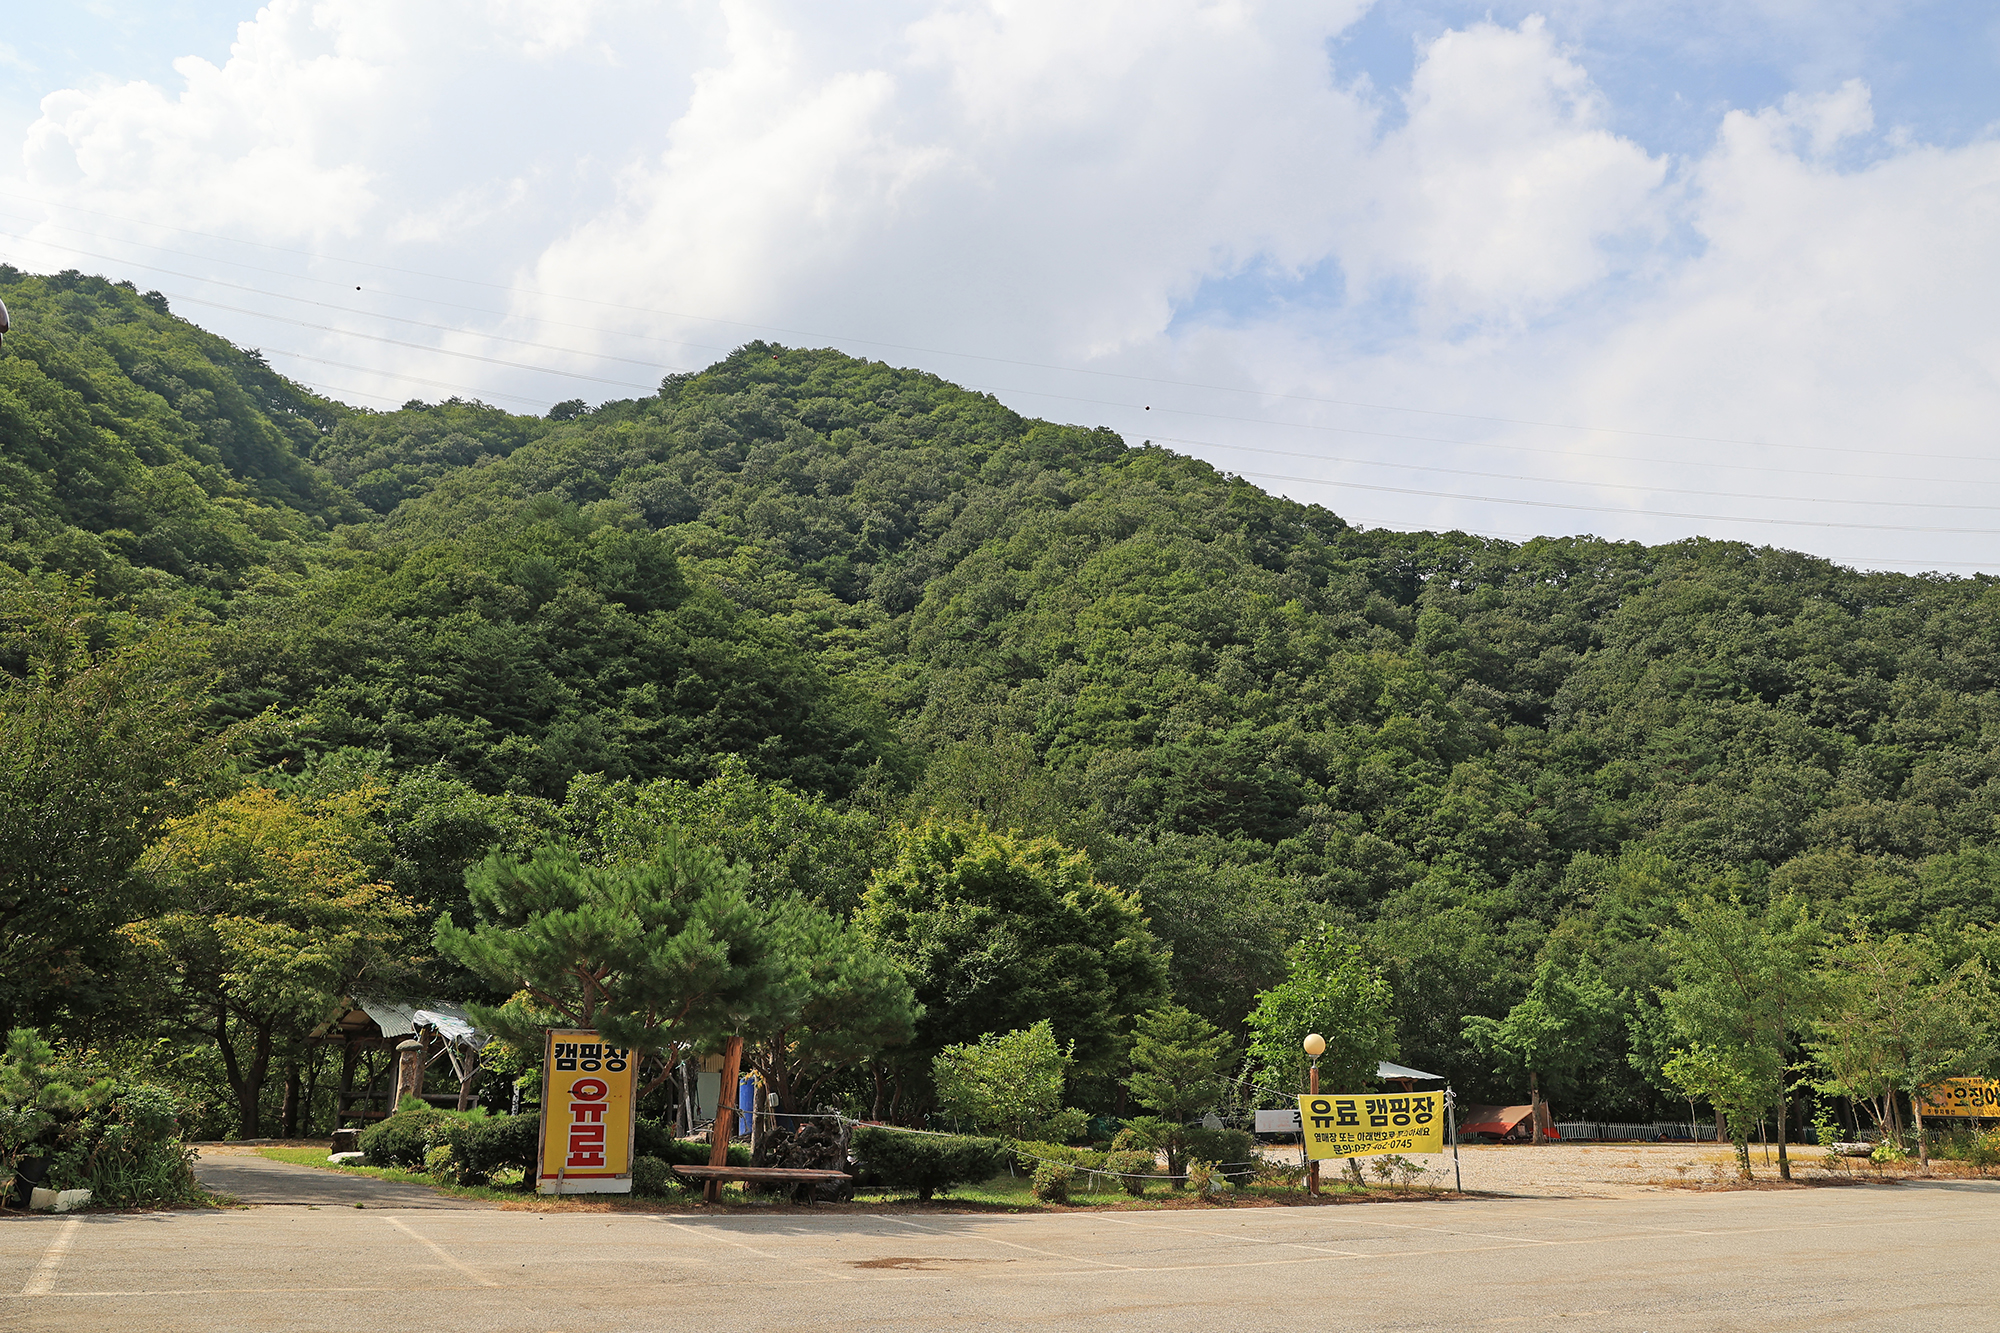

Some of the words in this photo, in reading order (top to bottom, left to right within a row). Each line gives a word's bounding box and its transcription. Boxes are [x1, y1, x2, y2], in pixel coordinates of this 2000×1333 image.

[554, 1042, 630, 1073] 캠핑장
[565, 1076, 609, 1169] 유료
[1310, 1099, 1360, 1128] 유료
[1366, 1096, 1435, 1127] 캠핑장
[1339, 1132, 1355, 1142] 또는
[1357, 1131, 1396, 1142] 아래번호로
